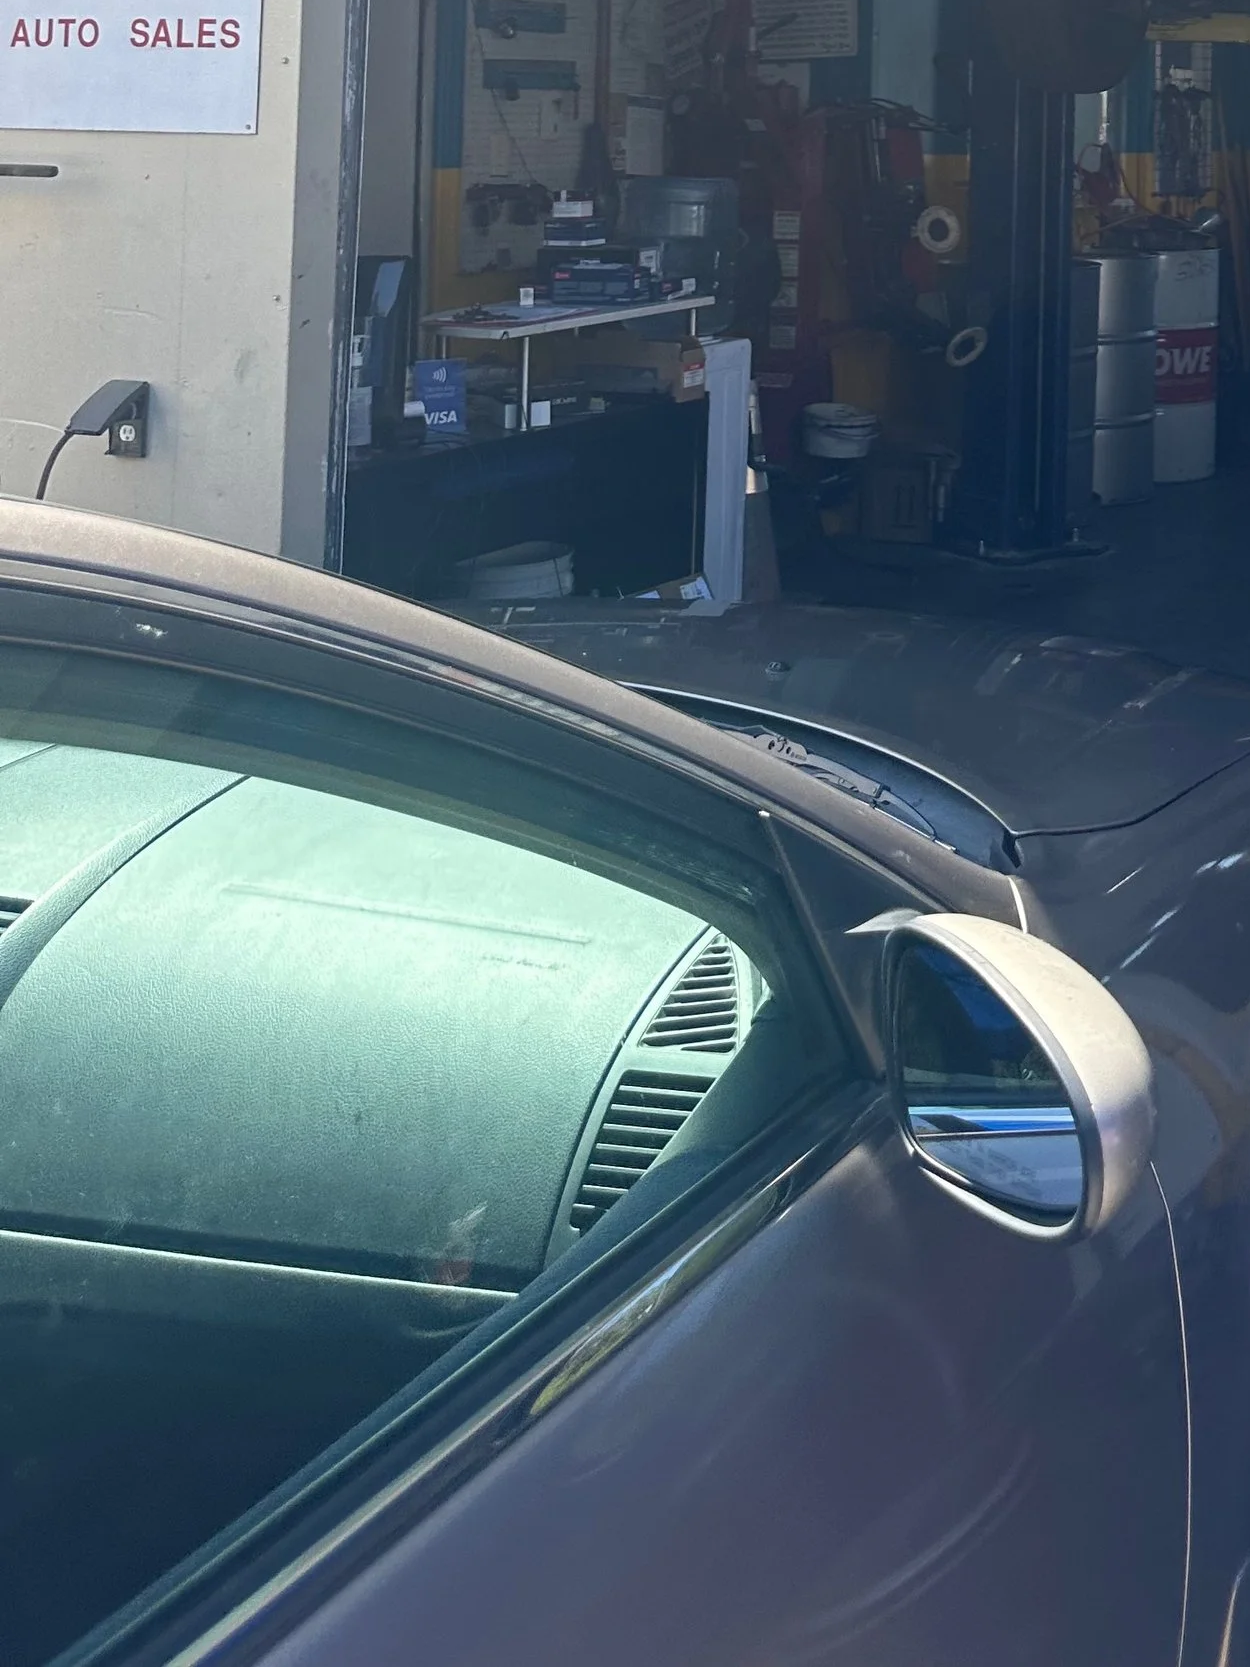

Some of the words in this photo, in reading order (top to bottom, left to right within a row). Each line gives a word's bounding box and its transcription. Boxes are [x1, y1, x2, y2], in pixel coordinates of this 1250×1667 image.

[10, 18, 100, 47] AUTO
[129, 18, 241, 48] SALES
[1154, 345, 1213, 376] OWE
[424, 410, 457, 425] VISA
